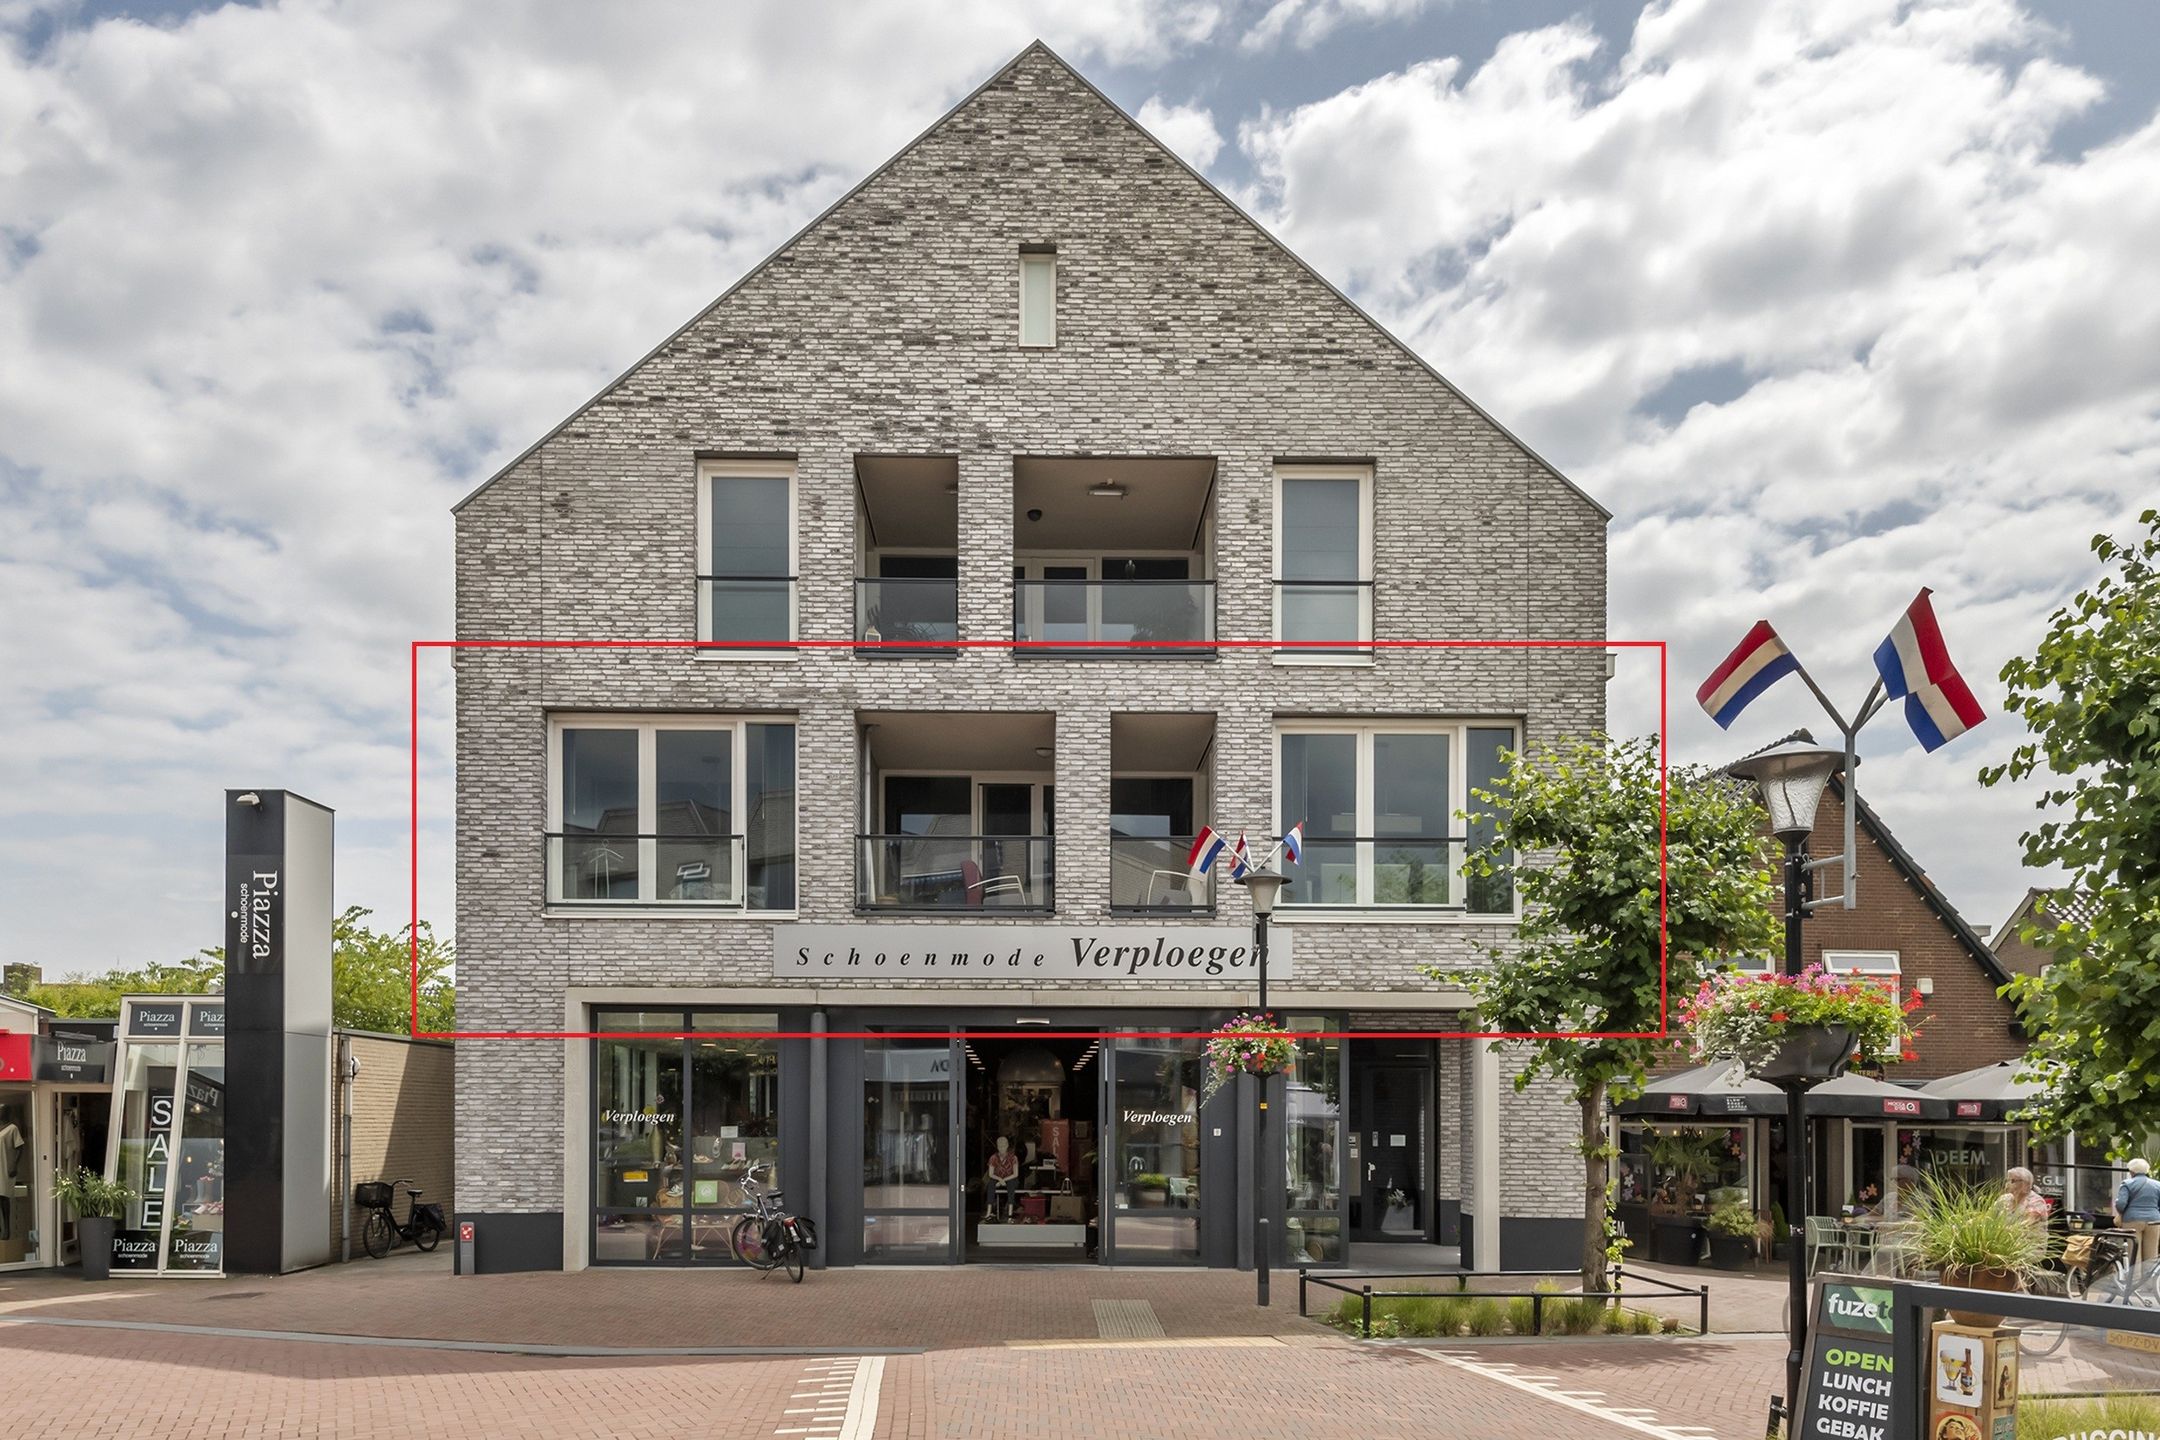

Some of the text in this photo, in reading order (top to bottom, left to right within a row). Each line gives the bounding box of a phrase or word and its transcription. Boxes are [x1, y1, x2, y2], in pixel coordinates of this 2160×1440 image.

[240, 883, 250, 944] schoenmode
[252, 870, 278, 960] Piazza
[796, 936, 1270, 975] Schoenmode Verploegen
[139, 1010, 175, 1022] Piazza
[199, 1010, 225, 1022] Piaz
[57, 1041, 87, 1062] Piazza
[604, 1109, 675, 1125] Verploegen
[1122, 1109, 1192, 1126] Verploegen
[142, 1100, 172, 1228] SALE
[112, 1238, 157, 1252] Piazza
[174, 1238, 218, 1253] Piazza
[1825, 1348, 1893, 1374] OPEN
[1822, 1371, 1892, 1397] LUNCH
[1818, 1394, 1889, 1421] KOFFIE
[1816, 1417, 1885, 1440] GEBAK
